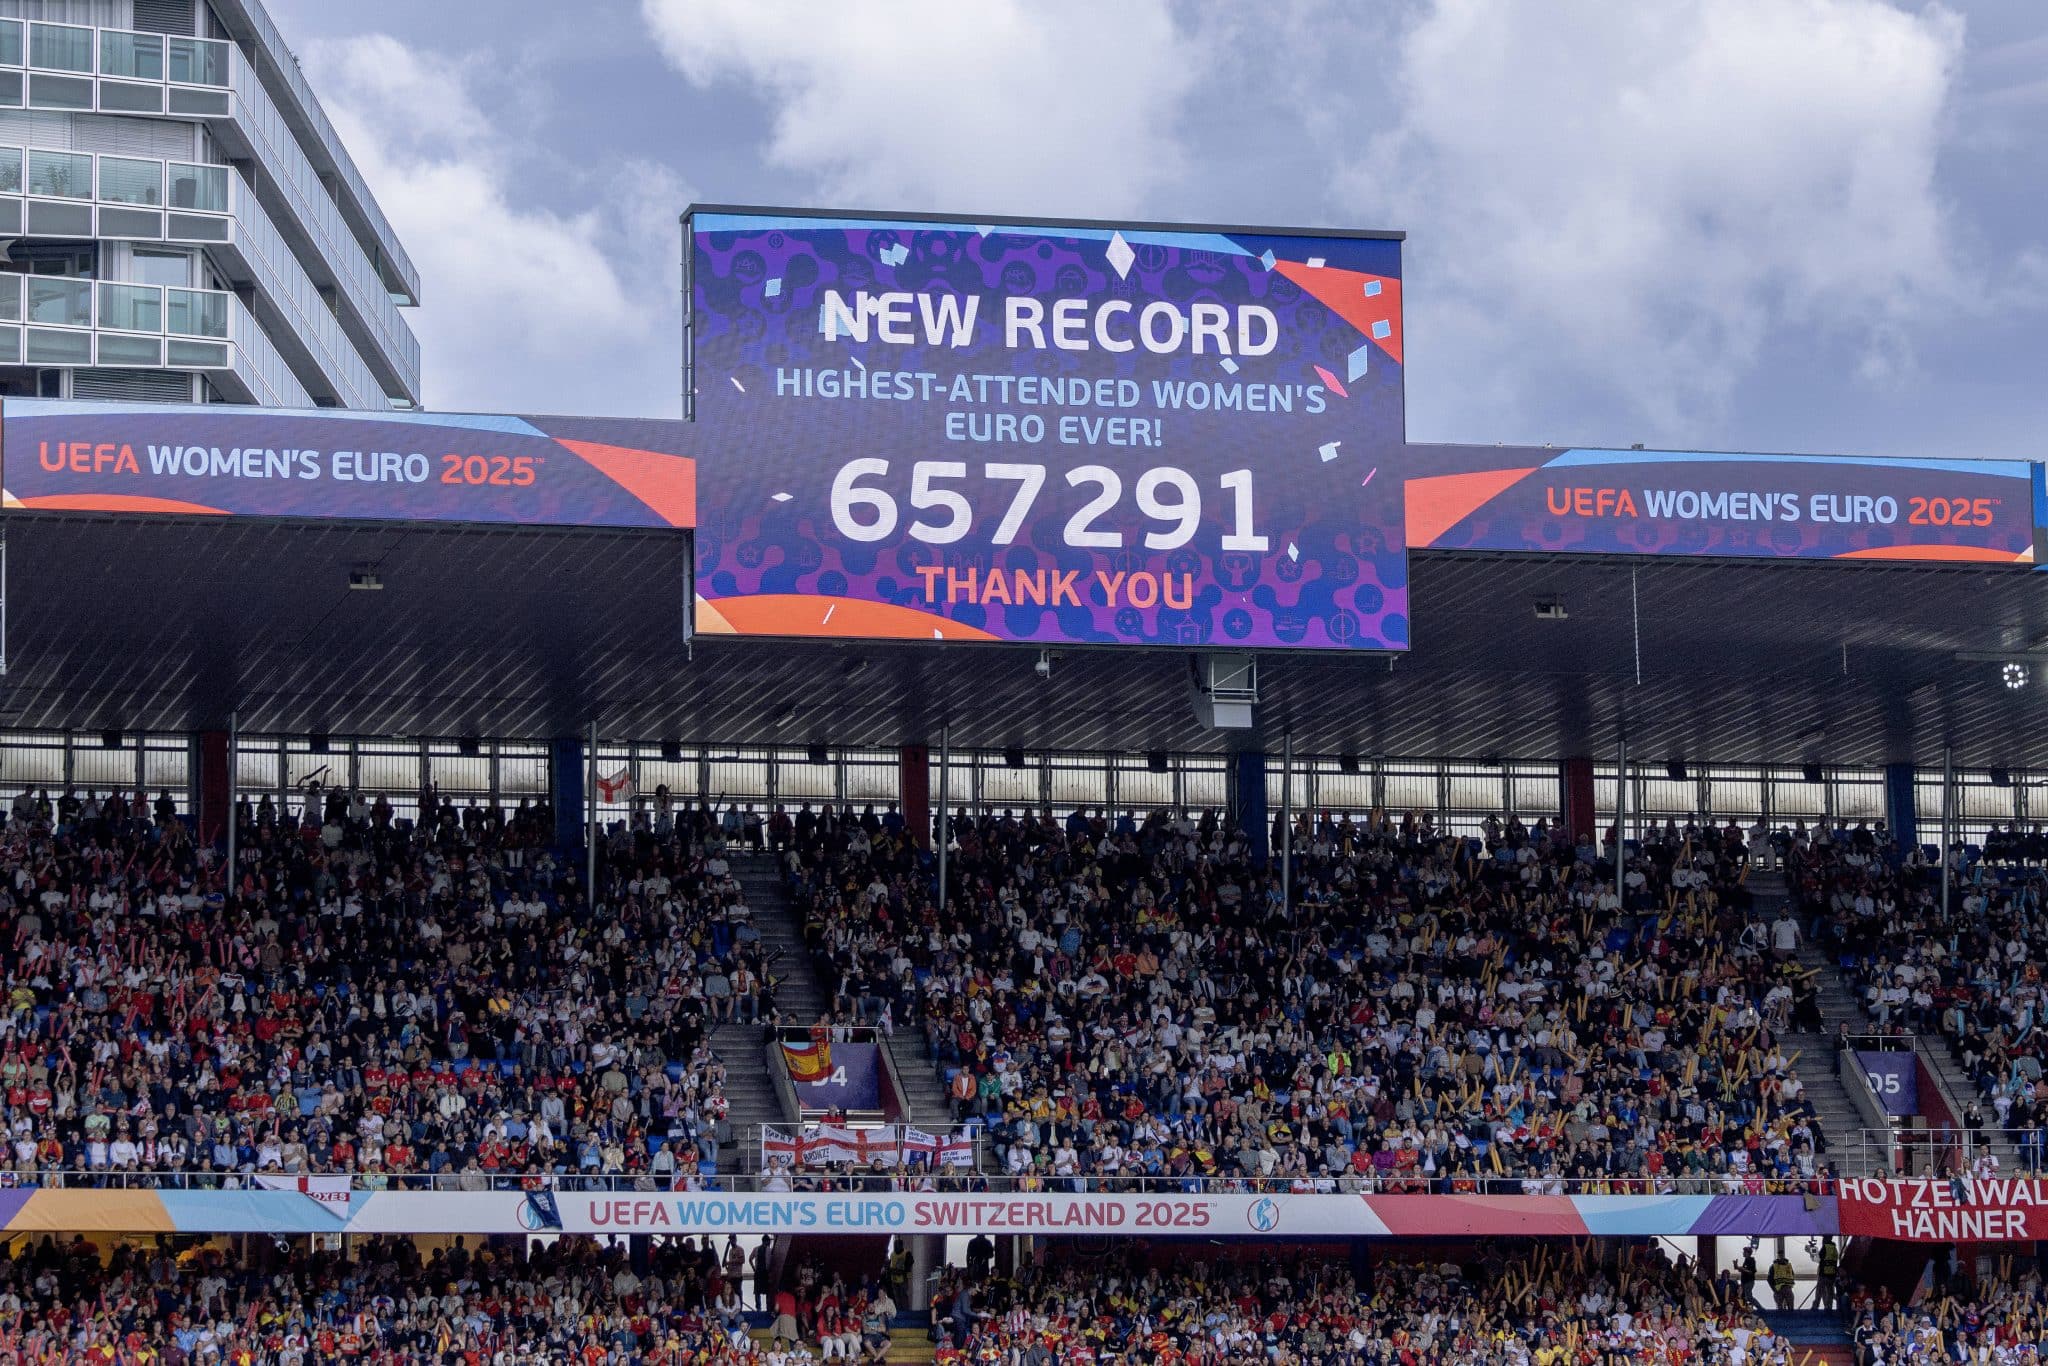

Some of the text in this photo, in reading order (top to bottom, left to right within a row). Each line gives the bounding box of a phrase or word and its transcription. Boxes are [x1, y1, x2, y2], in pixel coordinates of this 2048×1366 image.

[825, 290, 1279, 356] NEW RECORD
[777, 367, 1326, 414] HIGHEST-ATTENDED WOMEN'S
[946, 412, 1162, 447] EURO EVER!
[40, 442, 139, 474] UEFA
[146, 444, 320, 480] WOMEN'S
[332, 451, 430, 483] EURO
[830, 457, 1269, 552] 657291
[1547, 487, 1637, 517] UEFA
[1643, 489, 1800, 522] WOMEN'S
[1810, 494, 1898, 524] EURO
[915, 566, 1193, 610] THANK YOU
[590, 1201, 669, 1226] UEFA
[677, 1200, 817, 1227] WOMEN'S
[825, 1201, 906, 1227] EURO
[915, 1201, 1125, 1227] SWITZERLAND
[1891, 1208, 2029, 1239] HÄNNER
